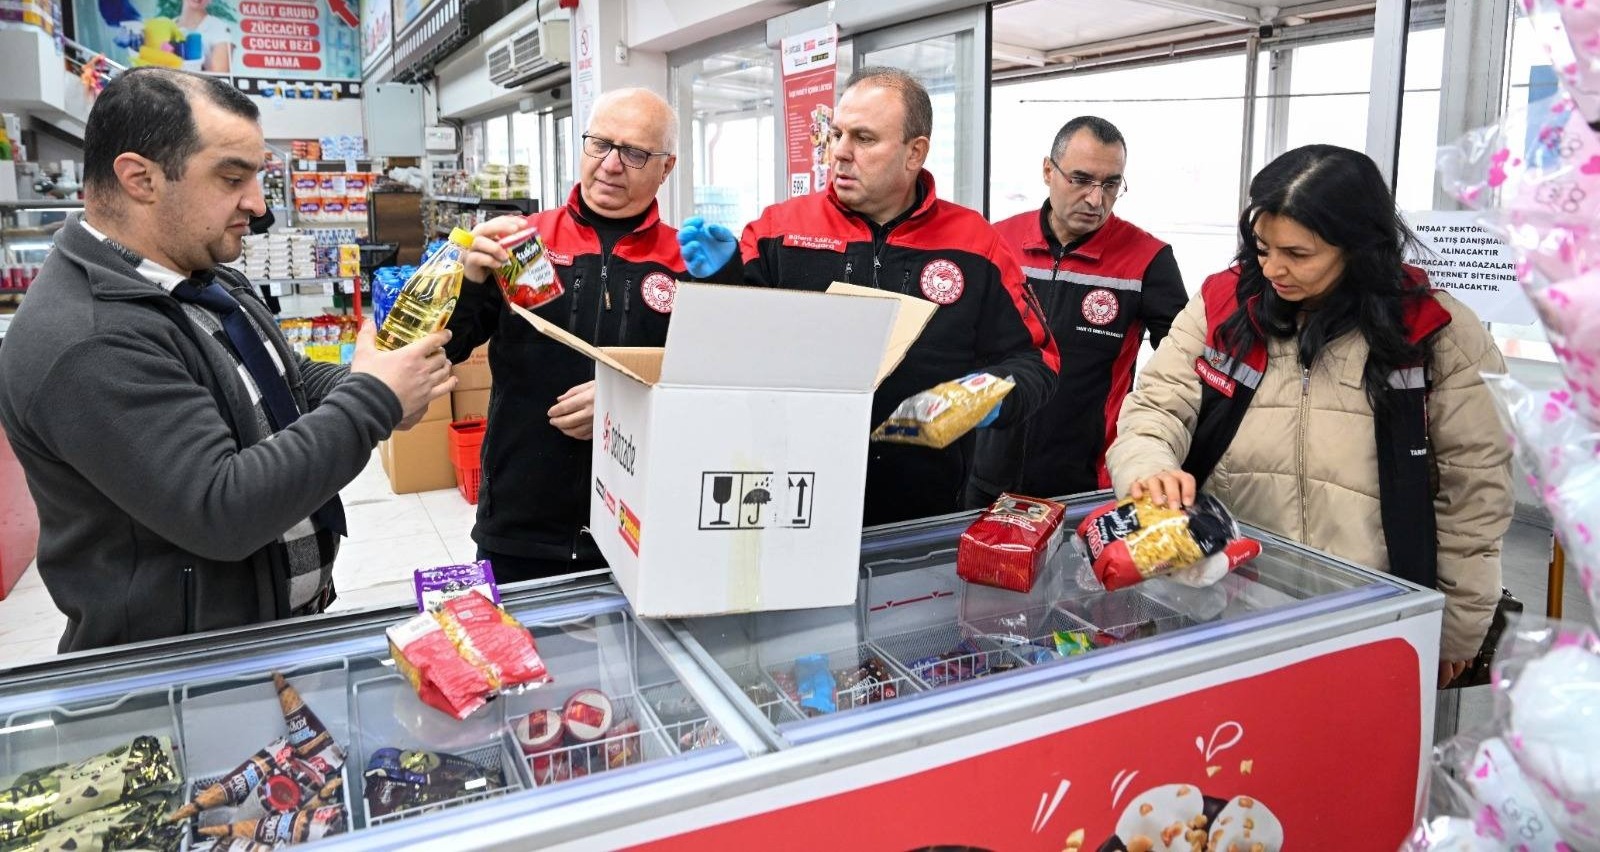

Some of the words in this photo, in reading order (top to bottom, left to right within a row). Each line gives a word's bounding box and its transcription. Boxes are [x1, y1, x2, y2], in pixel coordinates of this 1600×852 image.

[242, 2, 276, 16] KAĞIT
[279, 6, 316, 19] GRUBU
[250, 21, 310, 36] ZÜCCACİYE
[249, 37, 287, 51] ÇOCUK
[289, 38, 313, 51] BEZİ
[264, 56, 300, 68] MAMA
[1416, 224, 1447, 233] İNŞAAT
[1449, 225, 1488, 233] SEKTÖR
[1433, 236, 1458, 245] SATIŞ
[1440, 248, 1499, 256] ALINACAKTIR
[1427, 269, 1468, 279] İNTERNET
[1434, 281, 1500, 292] YAPILACAKTIR.
